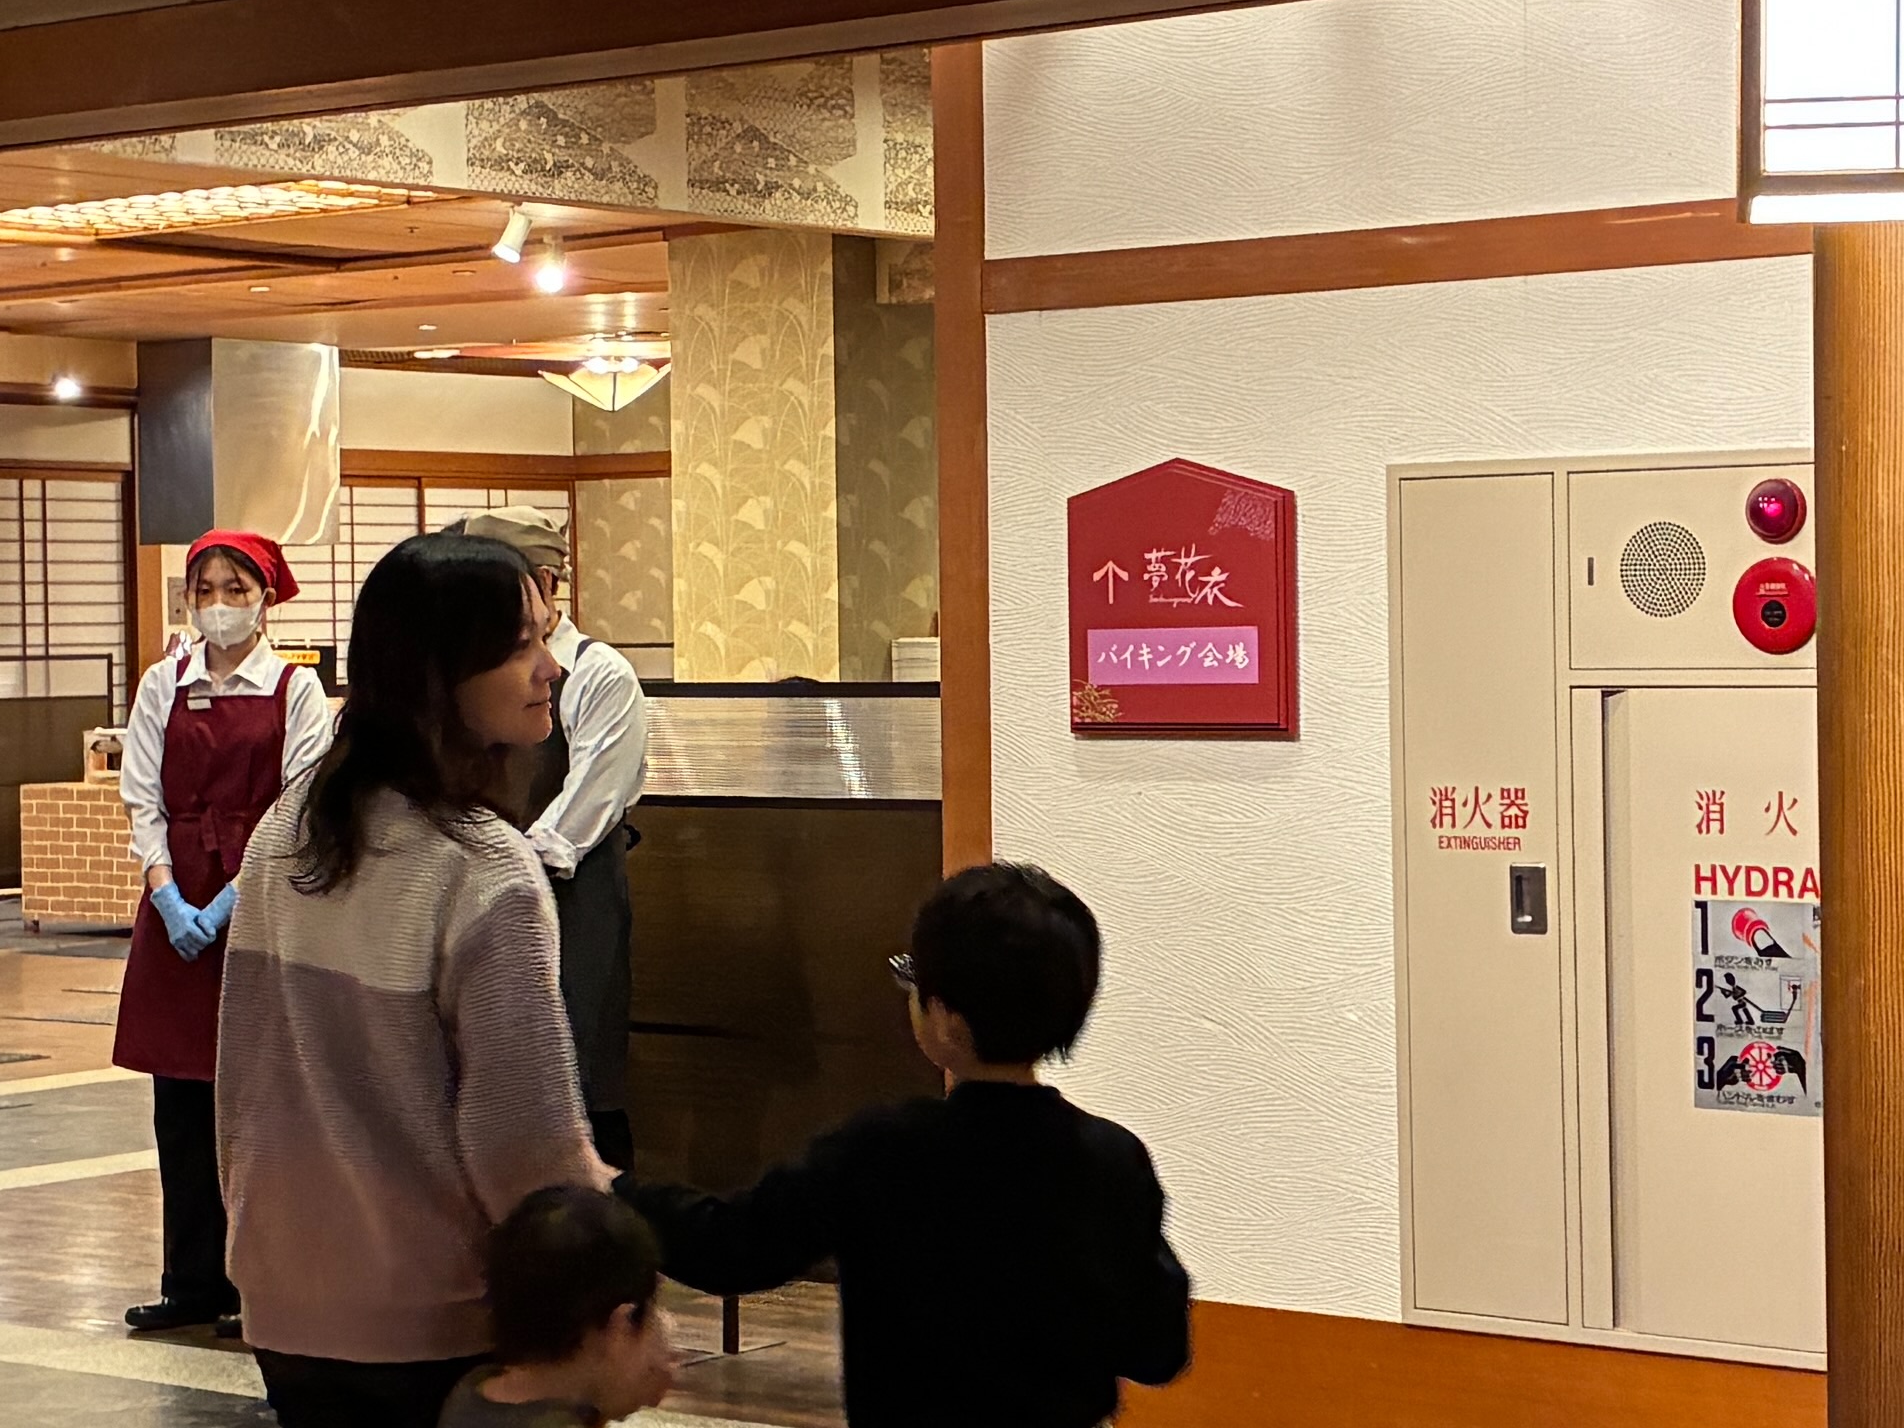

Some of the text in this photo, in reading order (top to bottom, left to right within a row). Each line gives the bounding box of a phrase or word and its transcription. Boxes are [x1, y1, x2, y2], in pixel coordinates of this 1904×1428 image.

[1143, 543, 1244, 607] 夢花衣
[1097, 642, 1250, 670] バイキング会場
[1429, 785, 1530, 831] 消火器
[1438, 835, 1522, 852] EXTINGUISHER
[1696, 968, 1715, 1022] 2
[1696, 1036, 1715, 1090] 3
